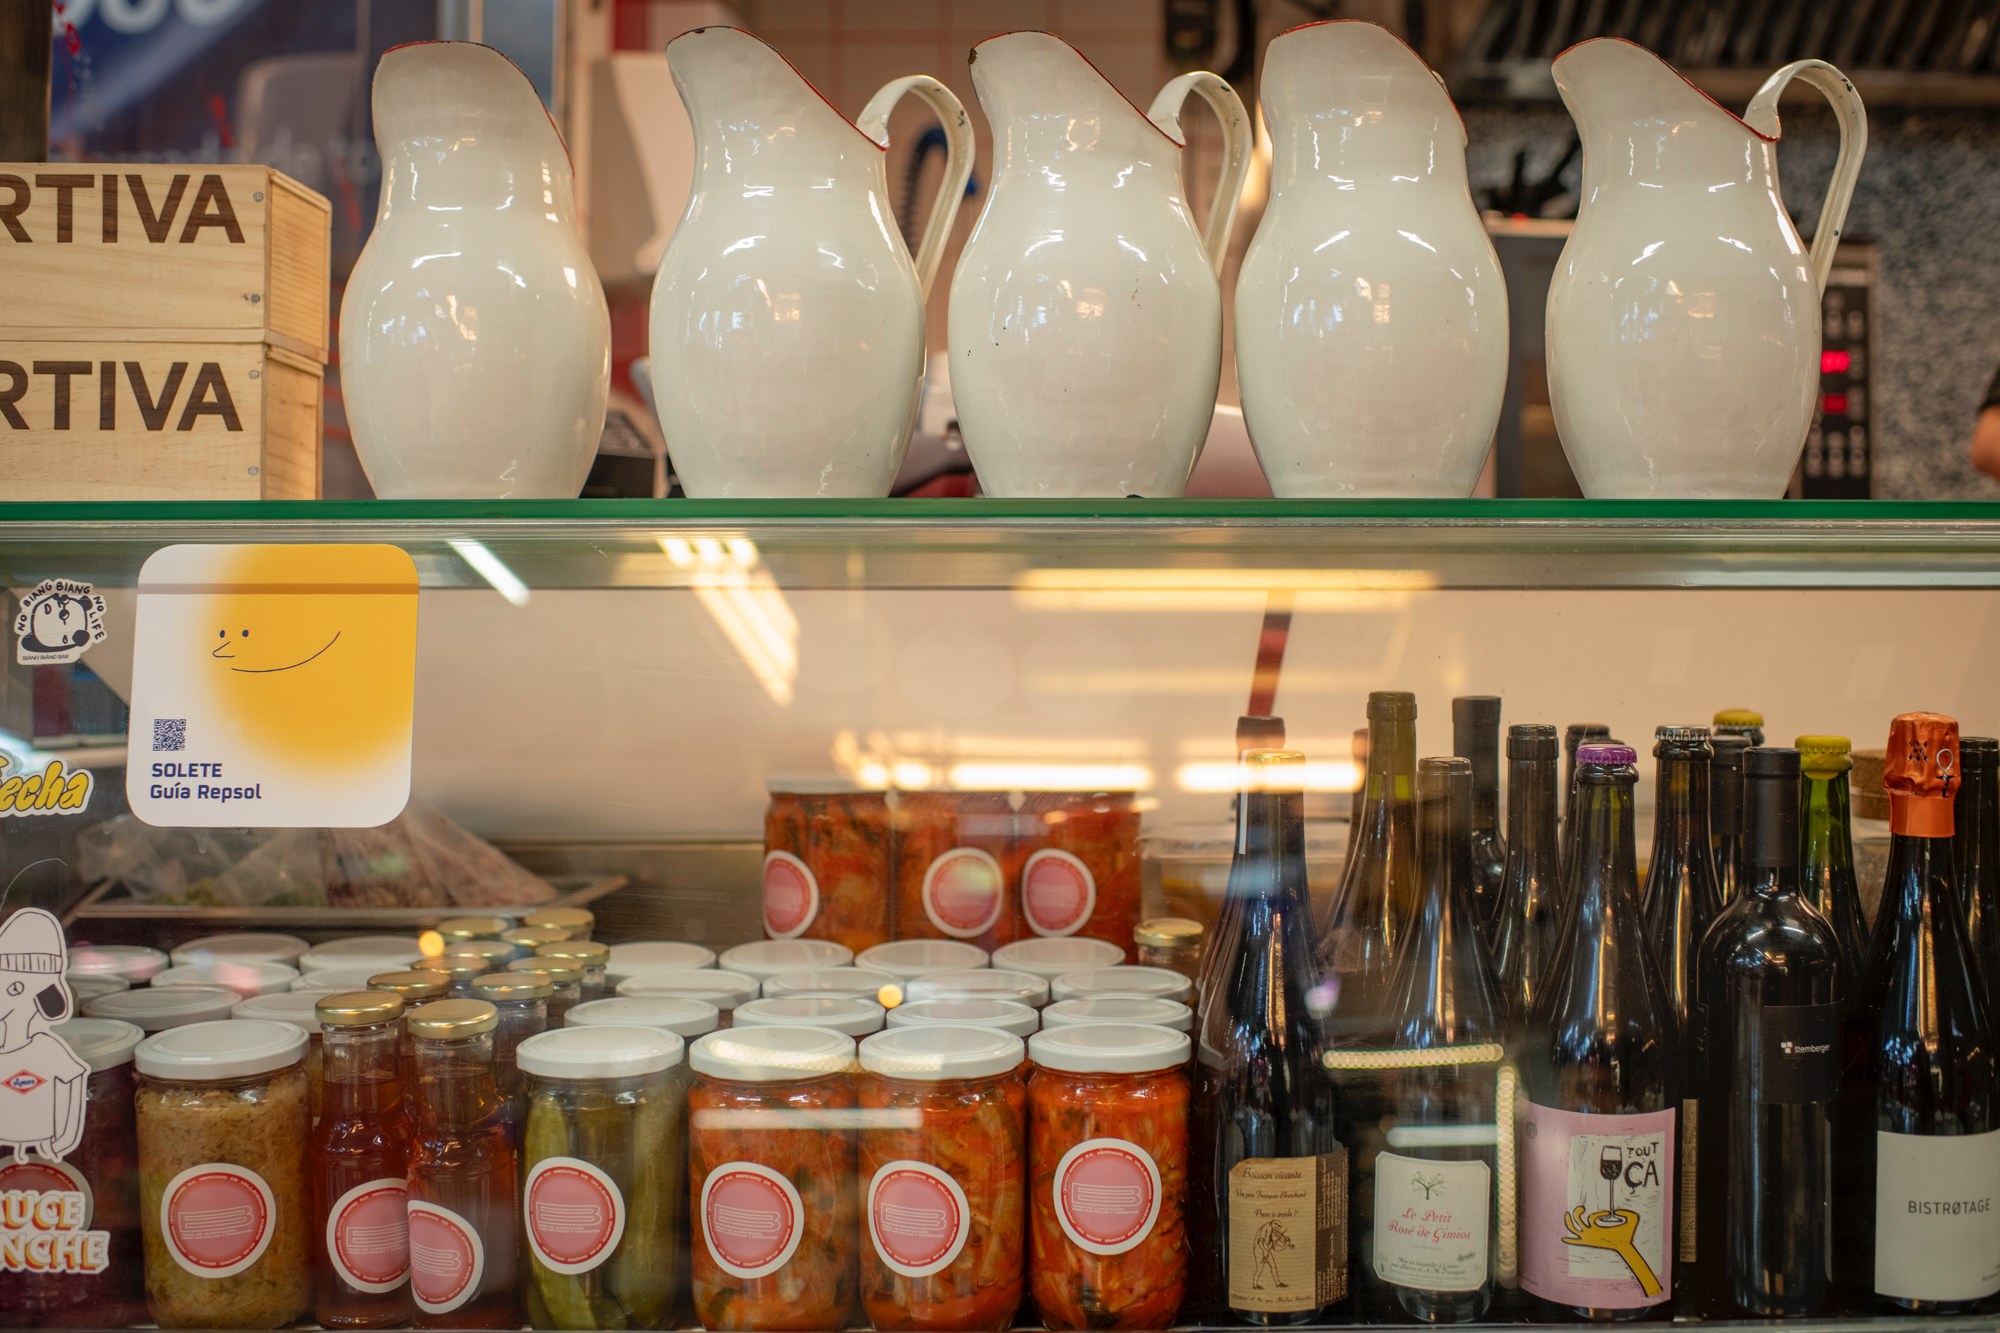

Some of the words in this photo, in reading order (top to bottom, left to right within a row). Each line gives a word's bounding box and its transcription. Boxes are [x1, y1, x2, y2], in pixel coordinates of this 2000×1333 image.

[0, 174, 246, 243] RTIVA
[0, 360, 243, 431] RTIVA
[23, 582, 52, 607] BIANG
[56, 581, 91, 594] BIANG
[93, 595, 104, 612] NO
[17, 614, 28, 632] NO
[89, 611, 105, 640] LIFE
[151, 763, 222, 778] SOLETE
[150, 782, 191, 799] Guía
[197, 783, 262, 803] Repsol
[1626, 1141, 1659, 1156] TOUT
[1242, 1167, 1273, 1180] Boisson
[1275, 1171, 1302, 1180] vivante
[1624, 1160, 1660, 1195] ÇA
[1402, 1207, 1417, 1220] Le
[1421, 1209, 1452, 1223] Petit
[1908, 1198, 1991, 1215] BISTRØTAGE
[1387, 1219, 1414, 1235] Rosé
[1417, 1225, 1431, 1238] de
[1432, 1227, 1472, 1243] Gimios
